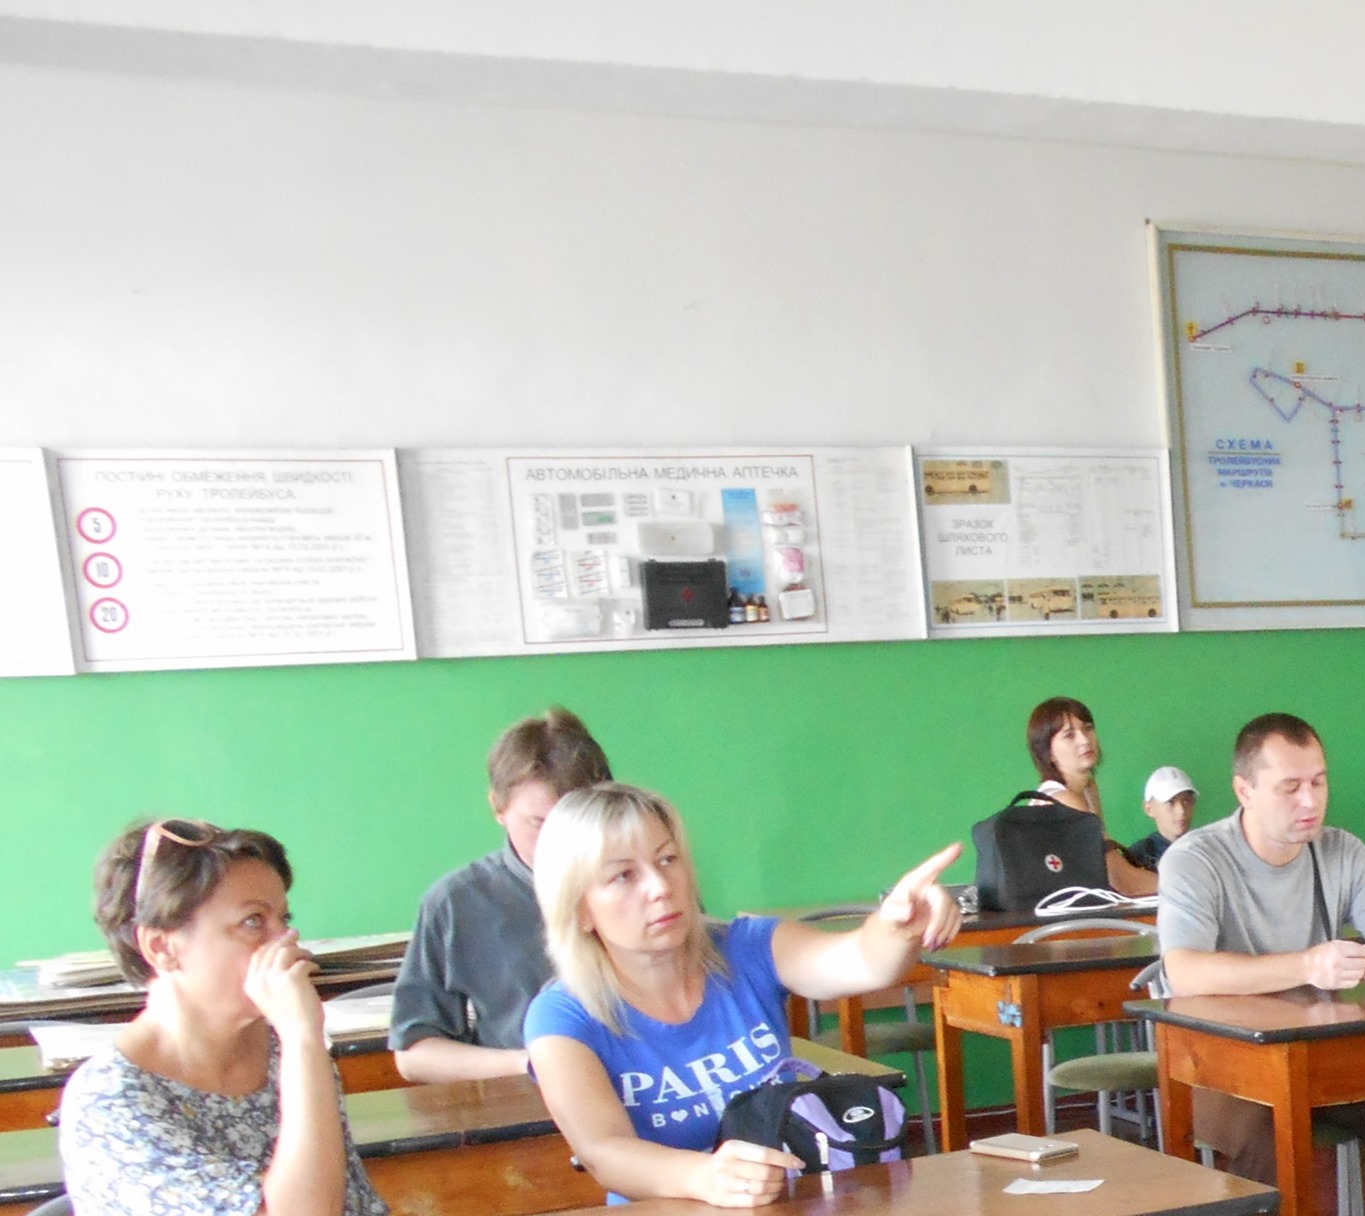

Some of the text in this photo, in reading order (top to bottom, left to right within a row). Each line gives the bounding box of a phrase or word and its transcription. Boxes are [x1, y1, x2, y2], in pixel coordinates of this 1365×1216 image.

[1216, 438, 1273, 450] СХЕМА
[171, 471, 266, 483] ОБМЕЖЕННЯ
[525, 465, 799, 481] АВТОМОБІЛЬНА МЕДИЧНА АПТЕЧКА
[91, 516, 102, 533] 5
[102, 606, 118, 622] 20
[620, 1022, 781, 1107] PARIS
